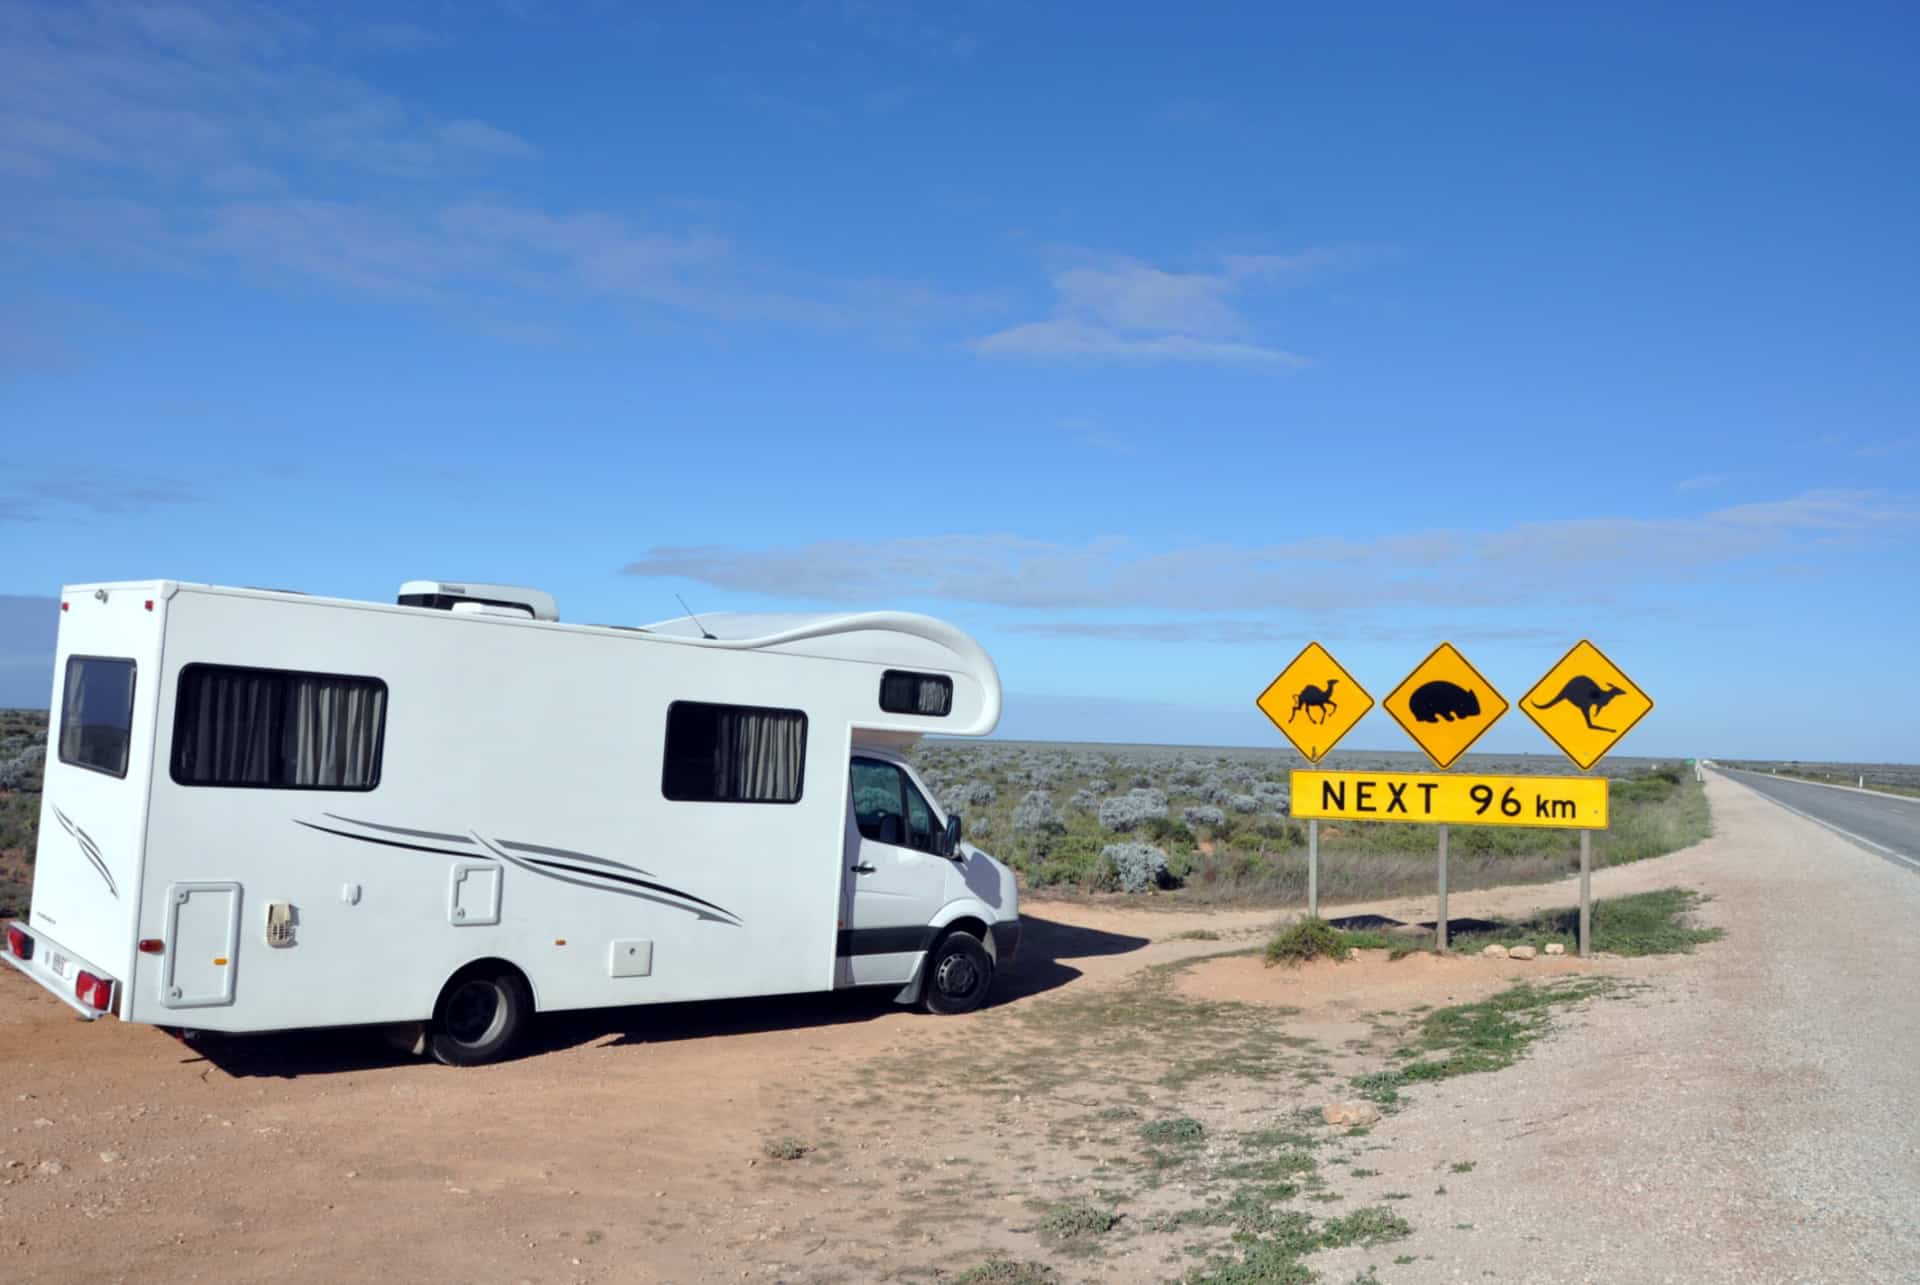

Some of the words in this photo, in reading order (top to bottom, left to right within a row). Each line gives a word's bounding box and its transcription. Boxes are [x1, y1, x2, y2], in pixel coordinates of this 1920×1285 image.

[1322, 780, 1439, 814] NEXT
[1469, 783, 1522, 817] 96
[1536, 794, 1577, 819] km
